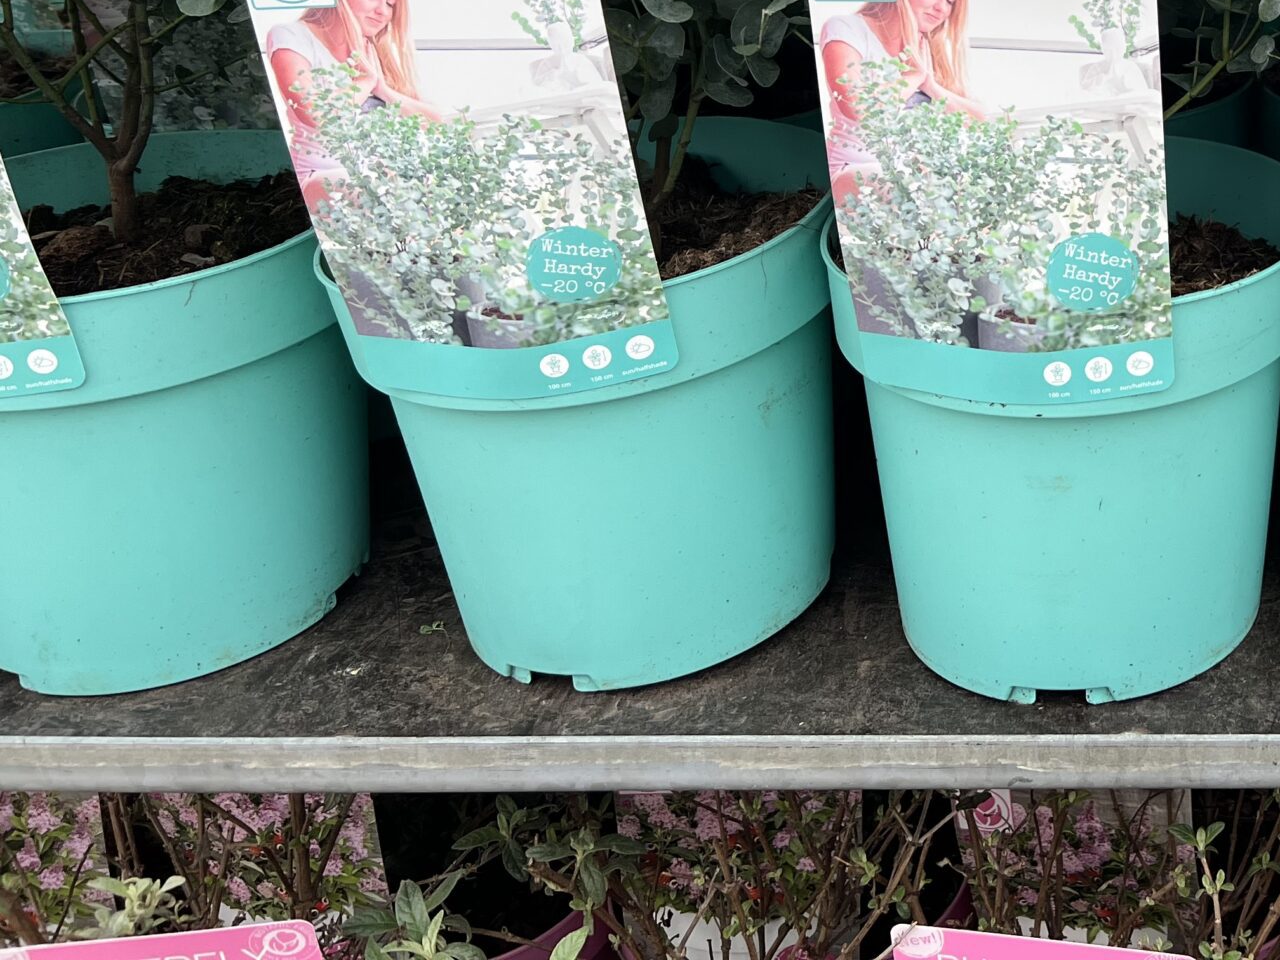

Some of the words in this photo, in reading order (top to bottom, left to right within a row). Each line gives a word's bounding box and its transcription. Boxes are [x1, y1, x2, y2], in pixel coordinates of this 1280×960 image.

[540, 239, 614, 258] Winter
[1064, 242, 1132, 268] Winter
[543, 259, 607, 279] Hardy
[1062, 264, 1123, 290] Hardy
[541, 280, 578, 293] -20
[1058, 286, 1093, 302] -20
